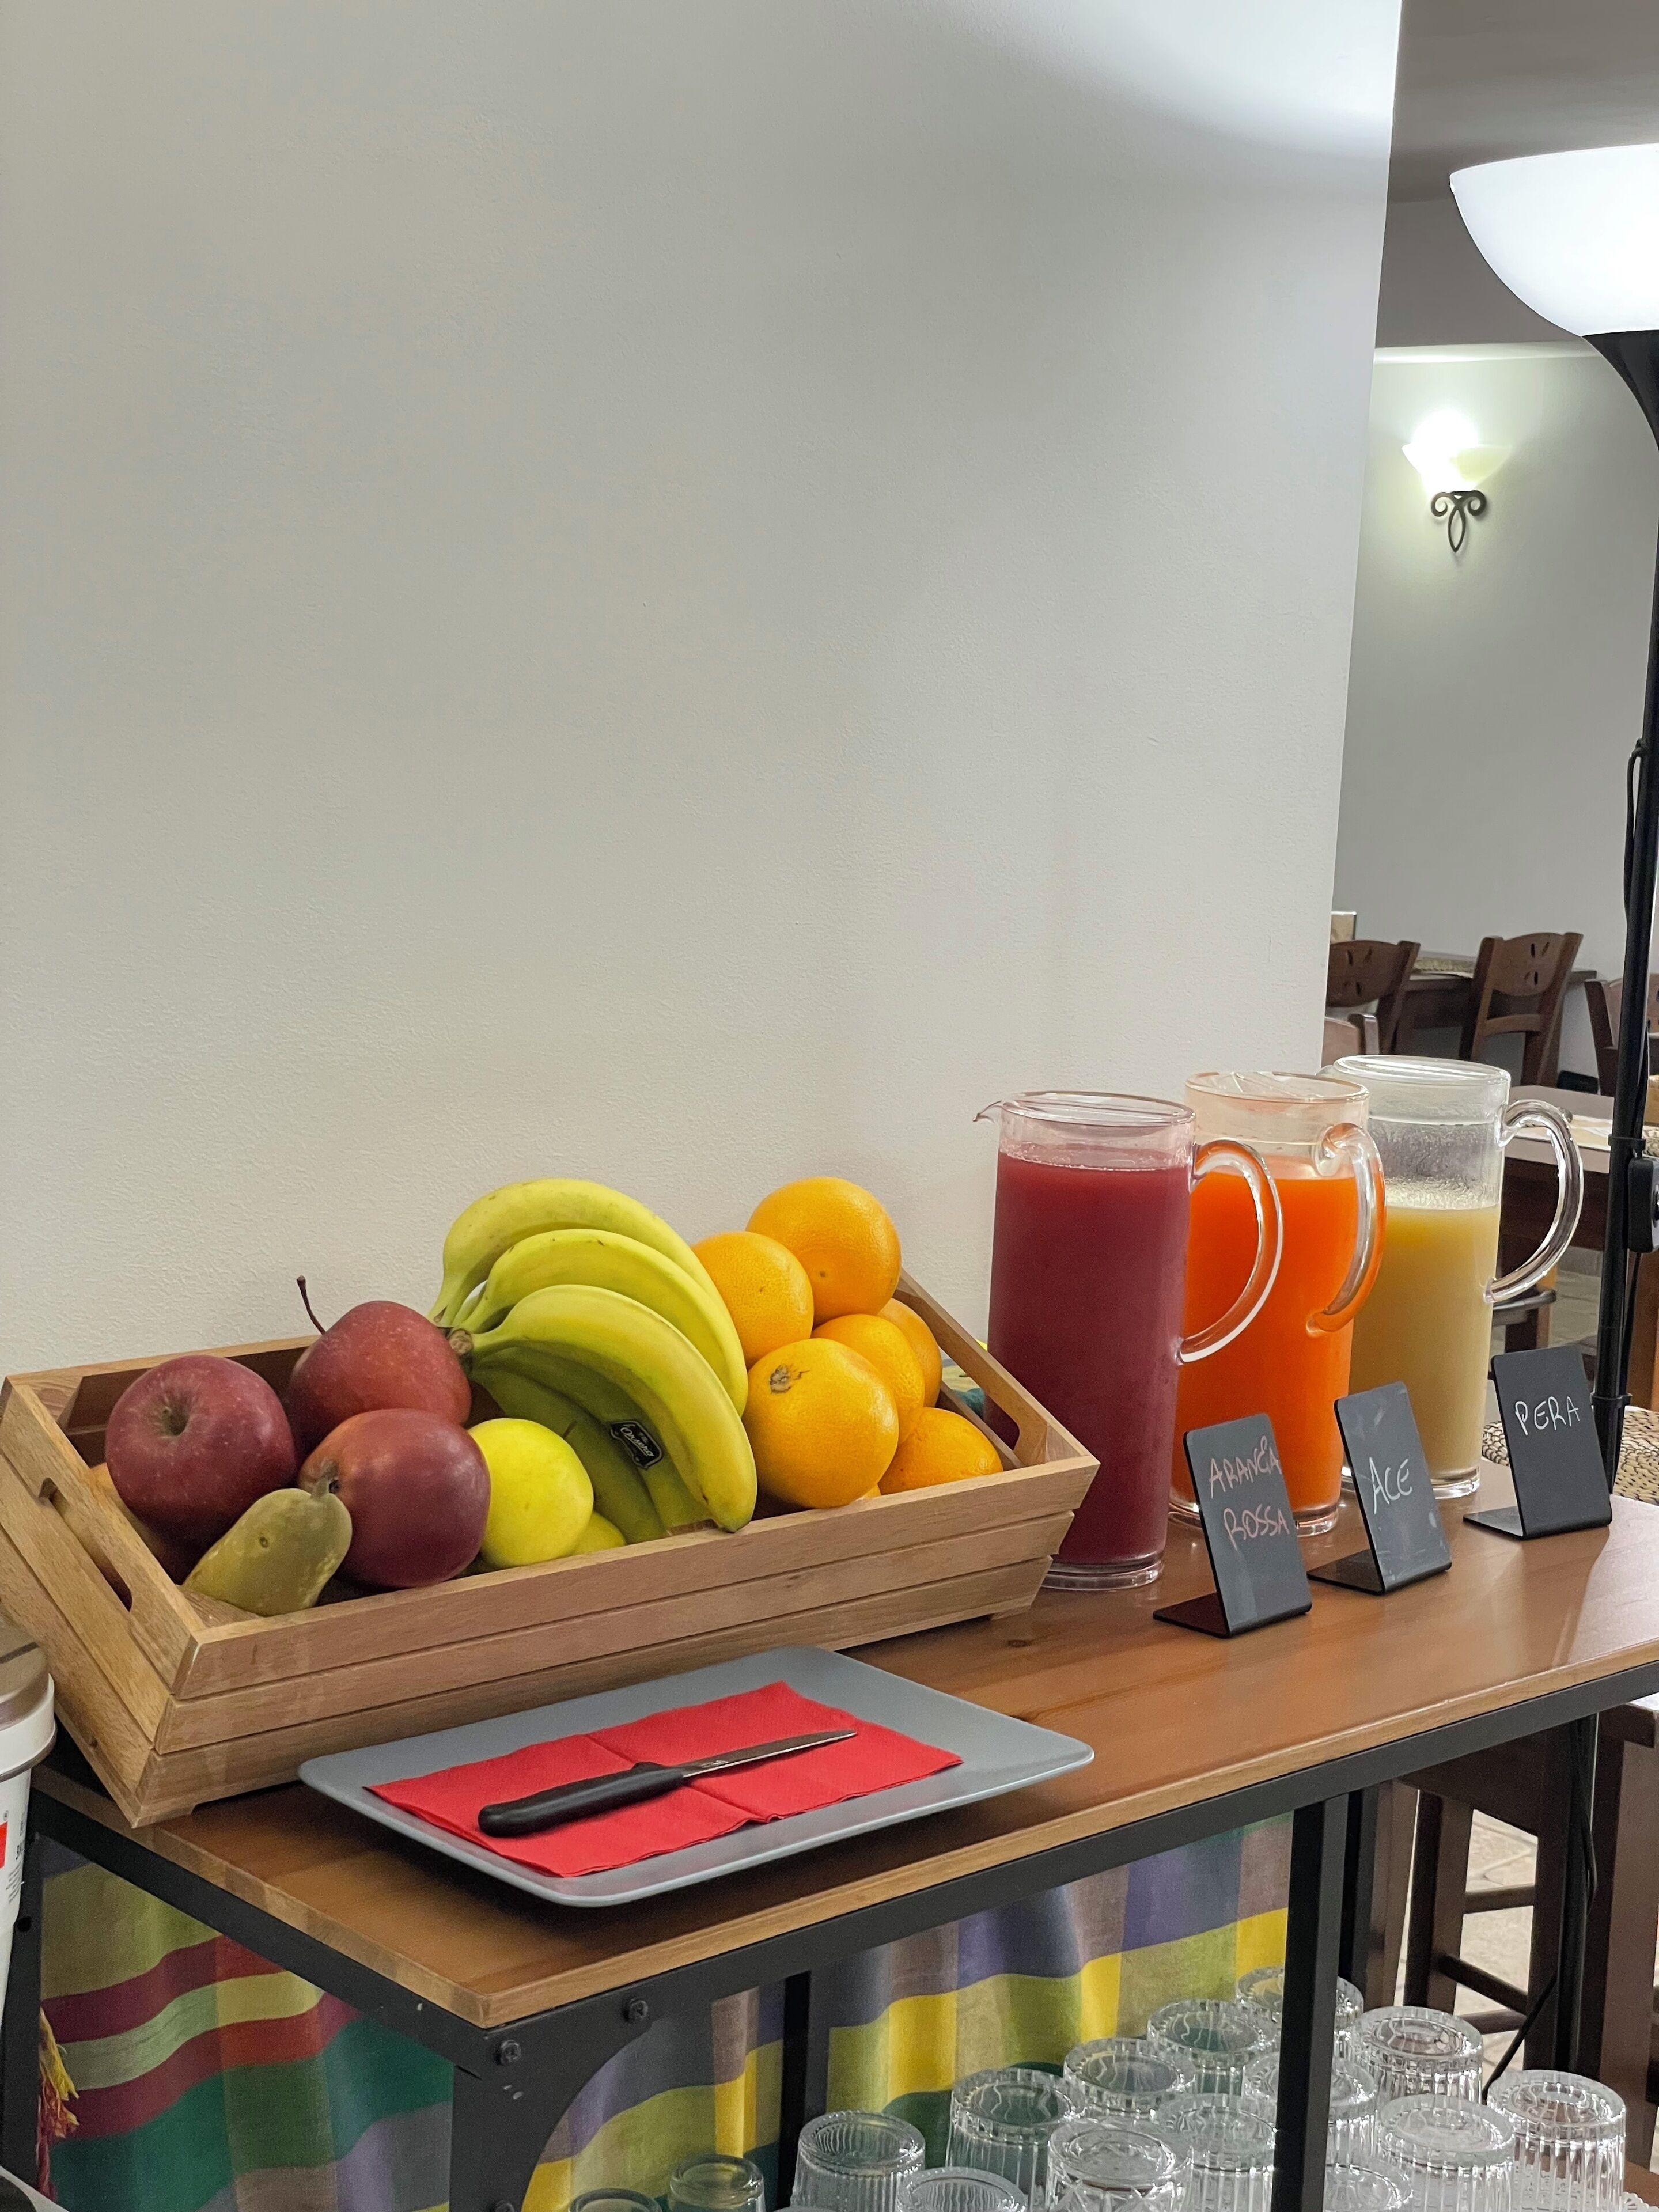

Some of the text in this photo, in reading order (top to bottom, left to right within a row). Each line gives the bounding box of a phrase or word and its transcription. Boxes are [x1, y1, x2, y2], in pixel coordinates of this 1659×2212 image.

[1514, 1396, 1580, 1435] PERA
[620, 1427, 654, 1457] Orsero
[1369, 1456, 1412, 1515] ACE
[1223, 1503, 1290, 1551] ROSSA
